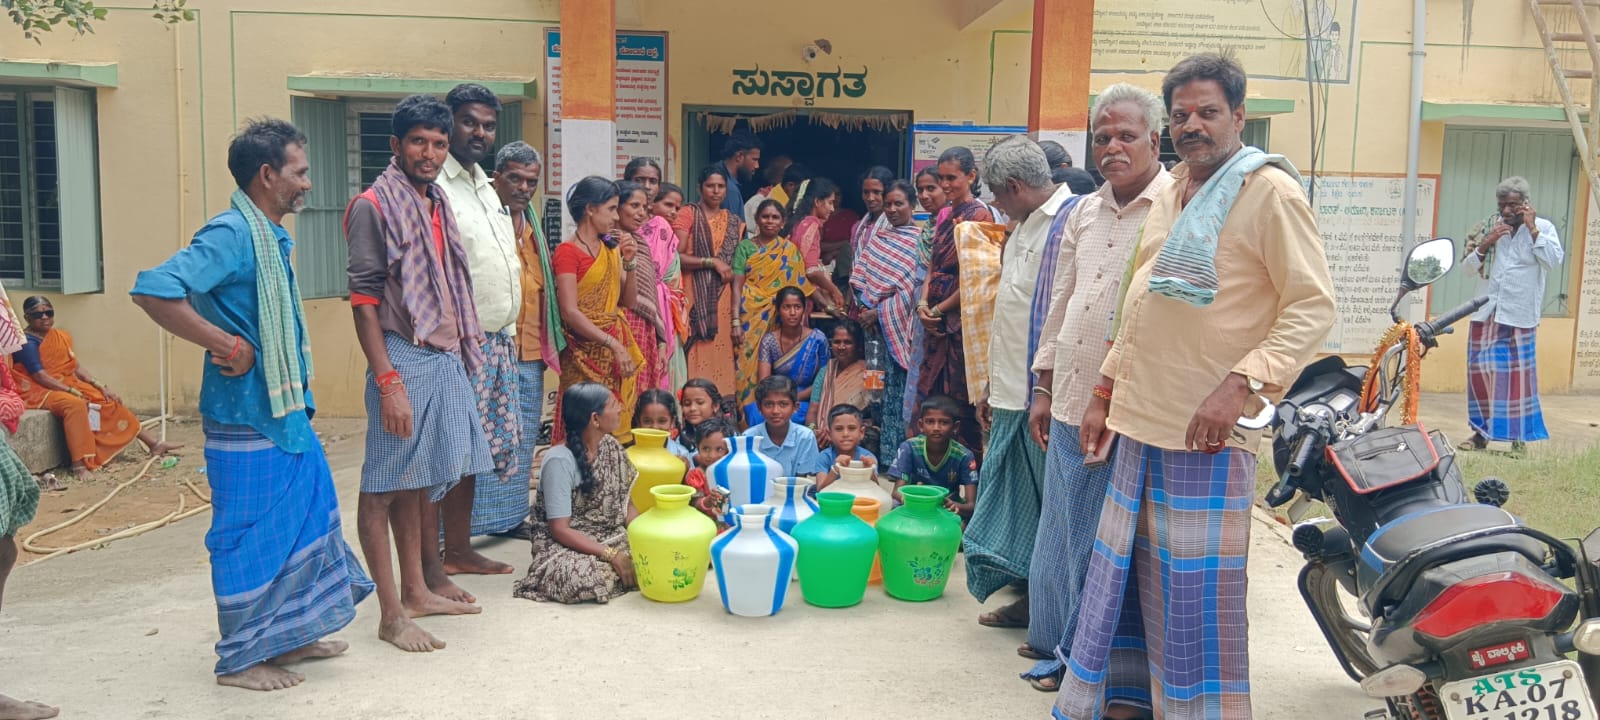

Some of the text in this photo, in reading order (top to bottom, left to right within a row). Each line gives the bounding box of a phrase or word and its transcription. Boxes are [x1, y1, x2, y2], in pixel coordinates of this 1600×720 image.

[732, 63, 868, 106] ಸುಸ್ವಾಗತ
[1472, 643, 1526, 666] ಜೈ ವಾಲ್ಮೀಕಿ
[1464, 678, 1566, 716] KA.07
[1472, 668, 1542, 696] ATS
